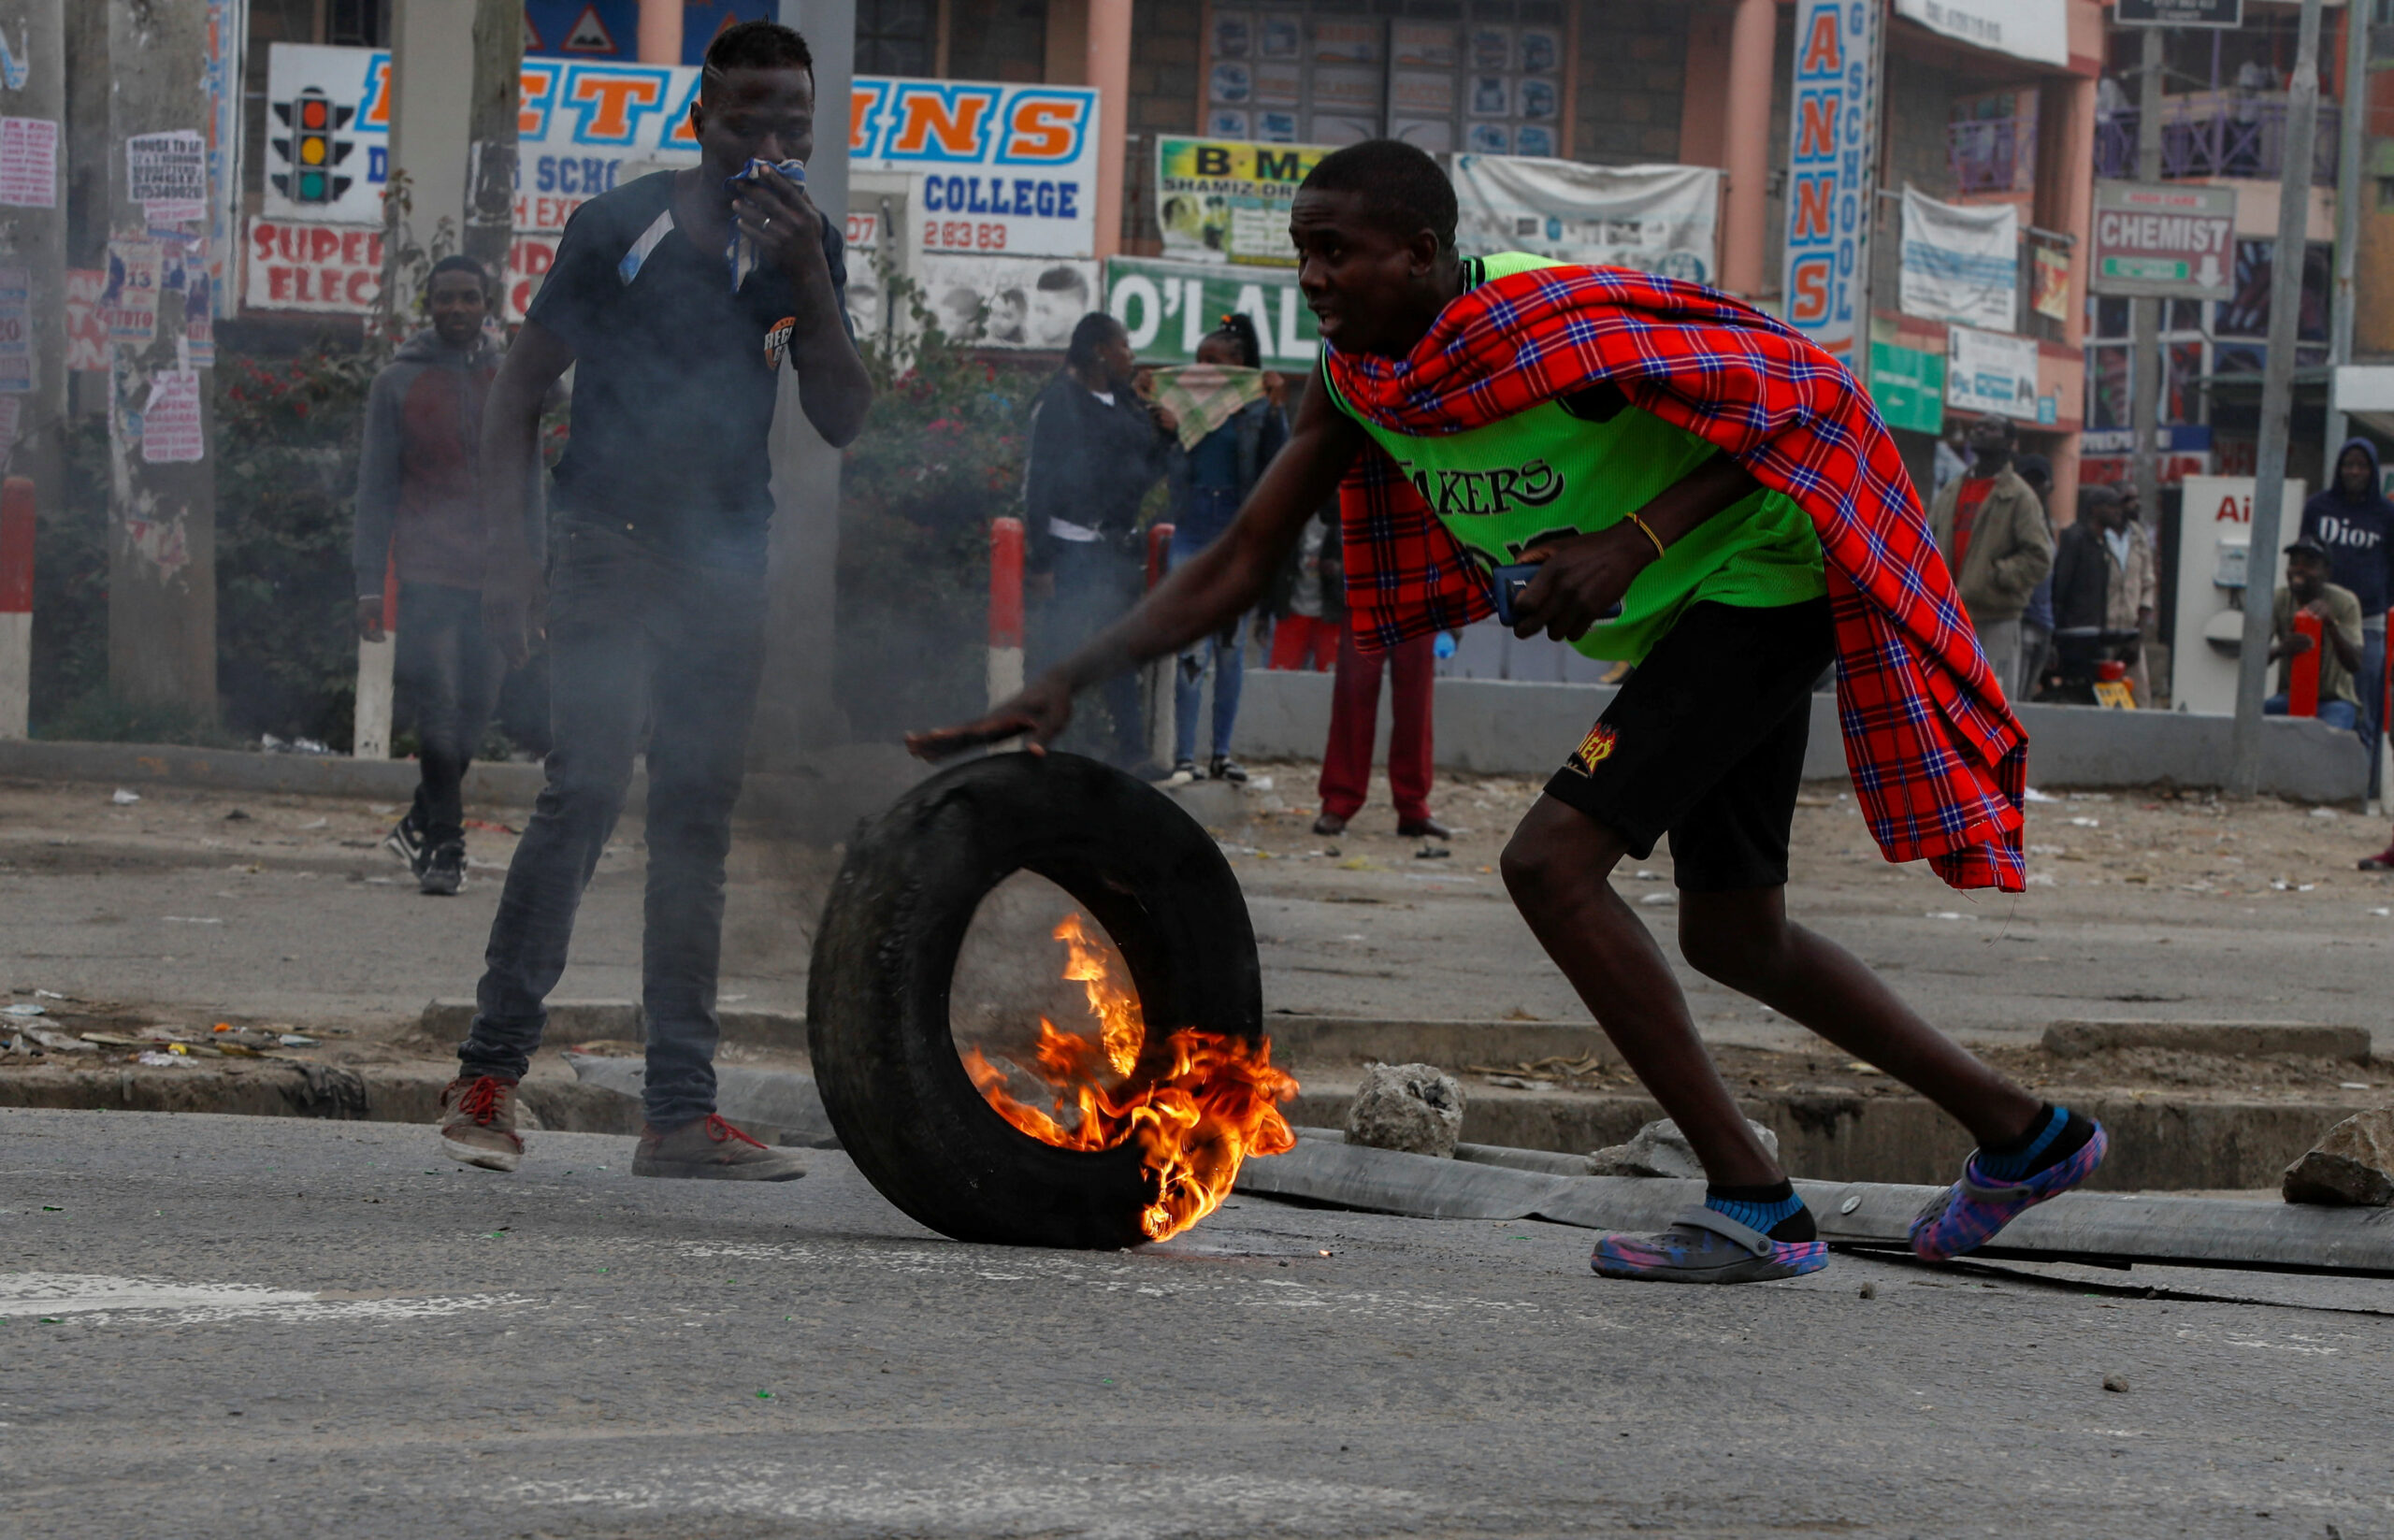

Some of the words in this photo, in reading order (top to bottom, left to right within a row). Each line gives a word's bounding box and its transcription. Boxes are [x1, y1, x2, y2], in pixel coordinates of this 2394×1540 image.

[924, 175, 1078, 219] COLLEGE
[1163, 178, 1254, 197] SHAMIZ
[2100, 213, 2230, 253] CHEMIST
[267, 266, 381, 307] ELEC
[1399, 458, 1565, 516] AKERS
[2215, 496, 2252, 523] Ai
[2318, 514, 2382, 550] Dior
